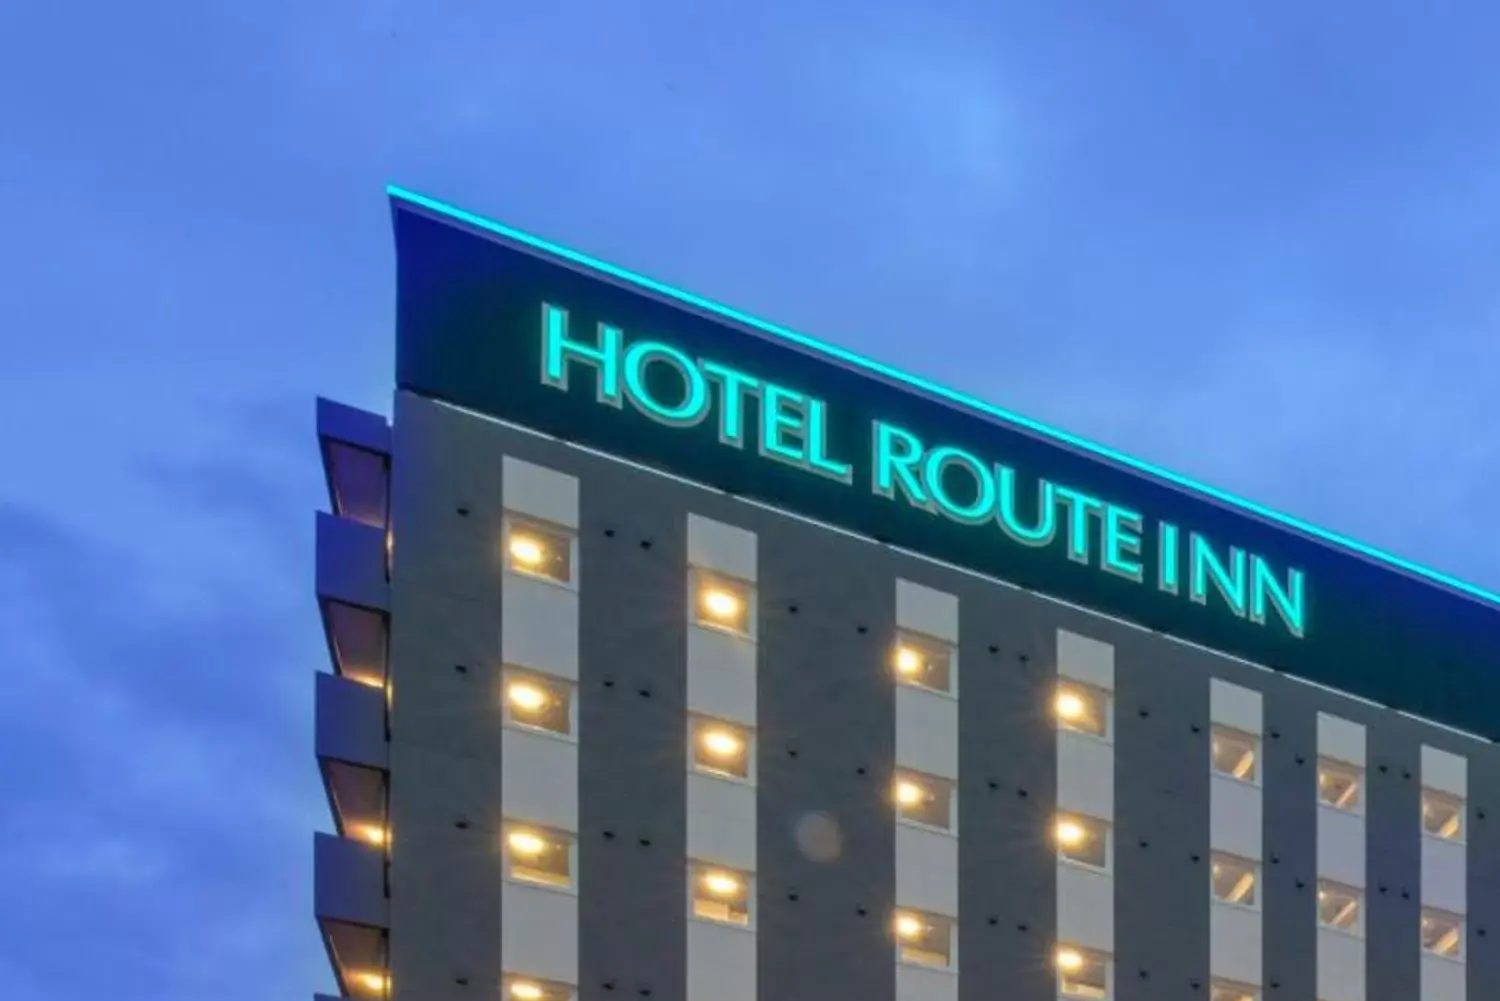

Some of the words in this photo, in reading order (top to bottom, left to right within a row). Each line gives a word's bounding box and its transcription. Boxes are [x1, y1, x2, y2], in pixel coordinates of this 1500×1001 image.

[540, 301, 852, 486] HOTEL
[872, 418, 1144, 584] ROUTE
[1158, 520, 1306, 638] INN
